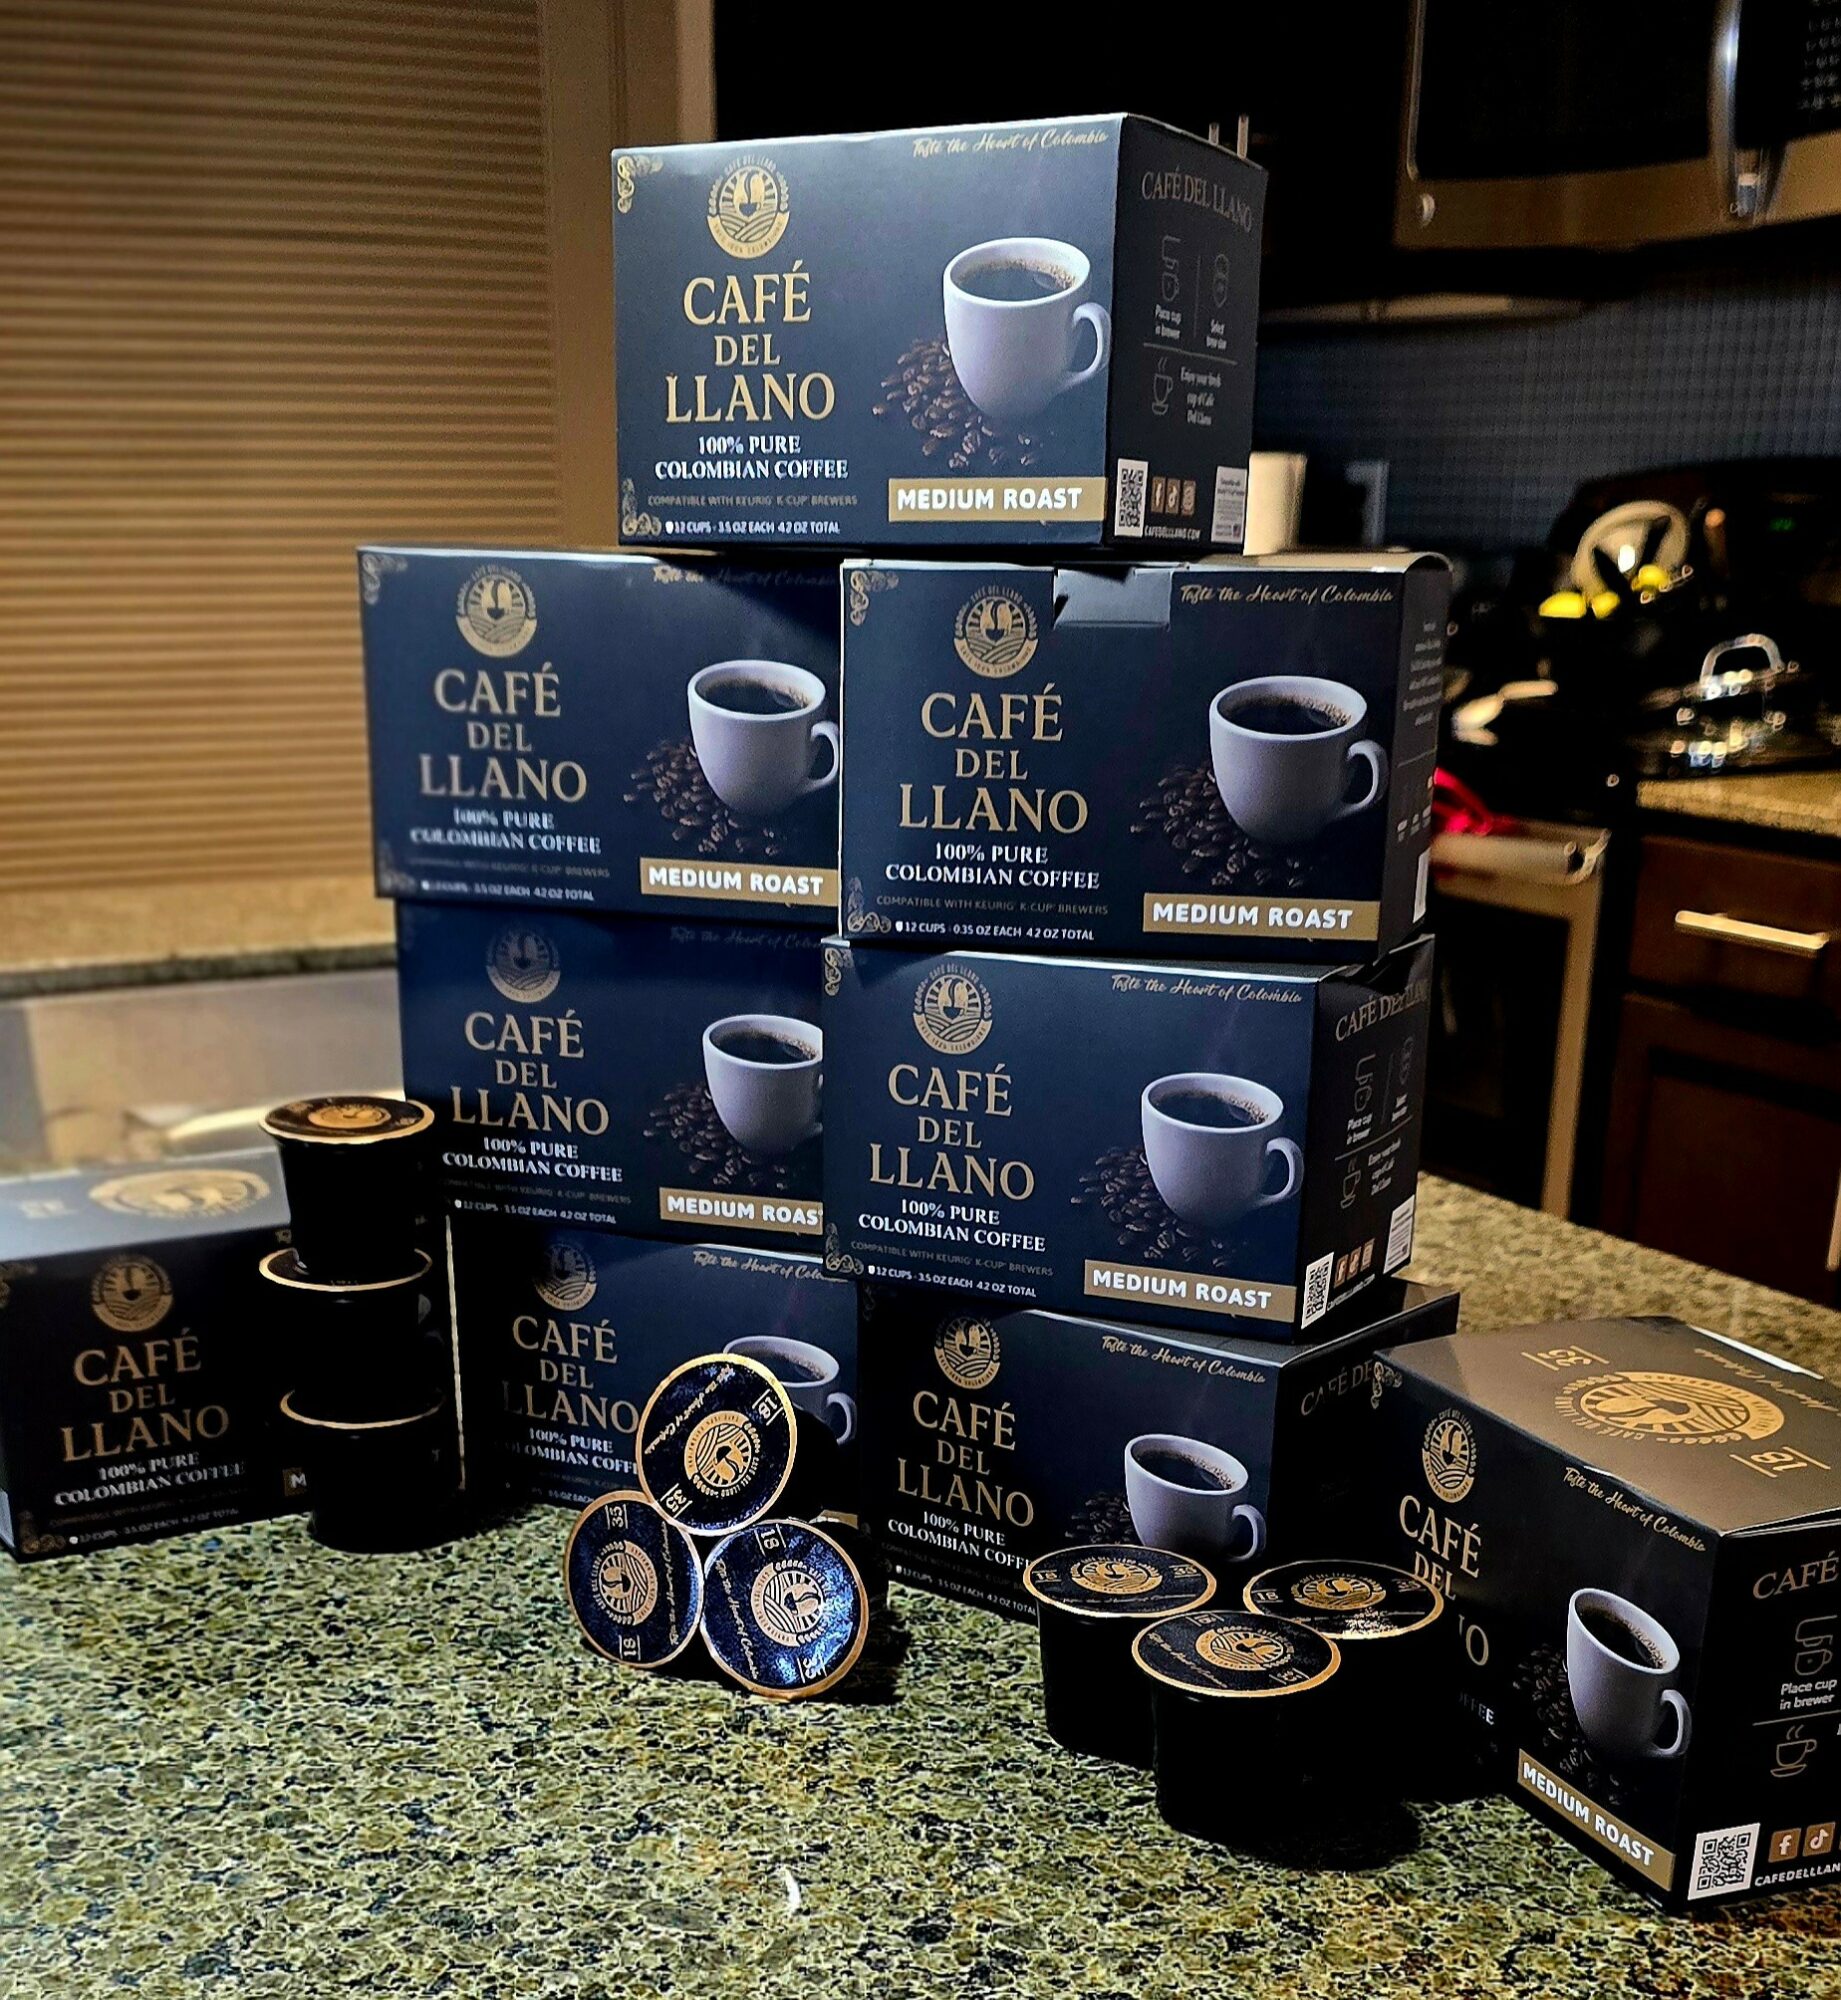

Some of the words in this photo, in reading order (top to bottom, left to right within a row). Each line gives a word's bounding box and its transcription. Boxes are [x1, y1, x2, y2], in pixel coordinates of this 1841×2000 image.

[1022, 132, 1039, 151] of
[1040, 127, 1109, 149] Colombia
[1142, 166, 1181, 200] CAFÉ
[1184, 175, 1210, 207] DEL
[683, 259, 811, 325] CAFÉ
[714, 333, 780, 366] DEL
[666, 372, 835, 422] LLANO
[698, 436, 743, 455] 100%
[749, 435, 801, 455] PURE
[655, 460, 769, 480] COLOMBIAN
[774, 459, 848, 480] COFFEE
[897, 488, 994, 511] MEDIUM
[1003, 487, 1083, 510] ROAST
[1180, 584, 1214, 604] Taste
[1217, 586, 1241, 601] the
[1246, 584, 1301, 604] Heart
[1300, 586, 1318, 604] of
[1320, 584, 1394, 604] Colombia
[434, 661, 561, 717] CAFÉ
[921, 683, 1063, 742] CAFÉ
[467, 720, 532, 752] DEL
[419, 753, 588, 803] LLANO
[955, 748, 1028, 780] DEL
[453, 807, 498, 826] 100%
[502, 810, 555, 829] PURE
[899, 783, 1088, 834] LLANO
[410, 827, 524, 850] COLOMBIAN
[528, 834, 602, 855] COFFEE
[936, 842, 985, 862] 100%
[991, 845, 1048, 865] PURE
[649, 867, 742, 891] MEDIUM
[750, 873, 823, 896] ROAST
[885, 864, 1013, 886] COLOMBIAN
[1018, 869, 1100, 891] COFFEE
[876, 895, 941, 908] COMPATIBLE
[944, 899, 973, 909] WITH
[1057, 903, 1109, 915] BREWERS
[1153, 902, 1258, 926] MEDIUM
[1268, 907, 1353, 929] ROAST
[905, 922, 916, 932] 12
[918, 923, 946, 934] CUPS
[976, 925, 991, 936] OZ
[993, 925, 1022, 938] EACH
[1043, 928, 1059, 939] OZ
[1061, 929, 1095, 941] TOTAL
[1111, 974, 1141, 992] Taste
[1144, 978, 1167, 992] the
[1170, 979, 1220, 996] Heart
[1218, 985, 1234, 1000] of
[1236, 984, 1302, 1003] Colombia
[464, 1008, 585, 1059] CAFÉ
[1335, 994, 1377, 1041] CAFÉ
[495, 1059, 558, 1089] DEL
[888, 1063, 1012, 1117] CAFÉ
[450, 1086, 610, 1136] LLANO
[483, 1137, 527, 1154] 100%
[530, 1141, 579, 1159] PURE
[918, 1115, 982, 1149] DEL
[442, 1151, 550, 1175] COLOMBIAN
[554, 1162, 623, 1183] COFFEE
[870, 1143, 1035, 1201] LLANO
[667, 1196, 755, 1220] MEDIUM
[762, 1204, 823, 1225] ROAS
[901, 1199, 945, 1219] 100%
[950, 1205, 1000, 1226] PURE
[858, 1213, 969, 1242] COLOMBIAN
[974, 1229, 1046, 1252] COFFEE
[851, 1241, 907, 1257] COMPATIBLE
[909, 1249, 934, 1261] WITH
[1009, 1262, 1053, 1276] BREWERS
[876, 1266, 886, 1276] 12
[888, 1268, 912, 1280] CUPS
[933, 1275, 946, 1285] OZ
[948, 1276, 973, 1288] EACH
[992, 1282, 1005, 1293] OZ
[1008, 1285, 1036, 1297] TOTAL
[1093, 1269, 1187, 1298] MEDIUM
[1195, 1282, 1272, 1309] ROAST
[512, 1315, 618, 1364] CAFÉ
[73, 1327, 202, 1386] CAFÉ
[1102, 1335, 1127, 1353] Taste
[1130, 1343, 1148, 1358] the
[1151, 1347, 1191, 1367] Heart
[1192, 1358, 1207, 1373] of
[1208, 1360, 1266, 1384] Colombia
[1537, 1348, 1592, 1367] 35
[539, 1358, 594, 1390] DEL
[108, 1384, 175, 1413] DEL
[758, 1396, 778, 1419] 18
[60, 1405, 229, 1462] LLANO
[913, 1390, 1015, 1450] CAFÉ
[528, 1427, 568, 1446] 100%
[570, 1434, 614, 1454] PURE
[98, 1460, 146, 1481] 100%
[150, 1452, 200, 1472] PURE
[937, 1439, 990, 1476] DEL
[1750, 1451, 1808, 1472] 18
[54, 1475, 171, 1505] COLOMBIAN
[665, 1489, 688, 1512] 35
[898, 1457, 1034, 1527] LLANO
[610, 1506, 624, 1528] 35
[1563, 1466, 1587, 1488] Taste
[1588, 1481, 1604, 1499] the
[1604, 1491, 1643, 1517] Heart
[1640, 1514, 1653, 1528] of
[1653, 1516, 1706, 1552] Colombia
[760, 1529, 780, 1550] 18
[888, 1519, 980, 1557] COLOMBIAN
[923, 1511, 960, 1534] 100%
[964, 1523, 1006, 1547] PURE
[1399, 1495, 1482, 1579] CAFÉ
[1414, 1551, 1456, 1601] DEL
[1752, 1550, 1839, 1599] CAFÉ
[1013, 1601, 1037, 1616] TOTAL
[1258, 1591, 1279, 1601] 18
[623, 1638, 637, 1656] 18
[1780, 1683, 1813, 1695] Place
[1815, 1679, 1838, 1691] cup
[1780, 1699, 1791, 1710] in
[1794, 1694, 1835, 1708] brewer
[1523, 1762, 1589, 1824] MEDIUM
[1595, 1814, 1655, 1866] ROAST
